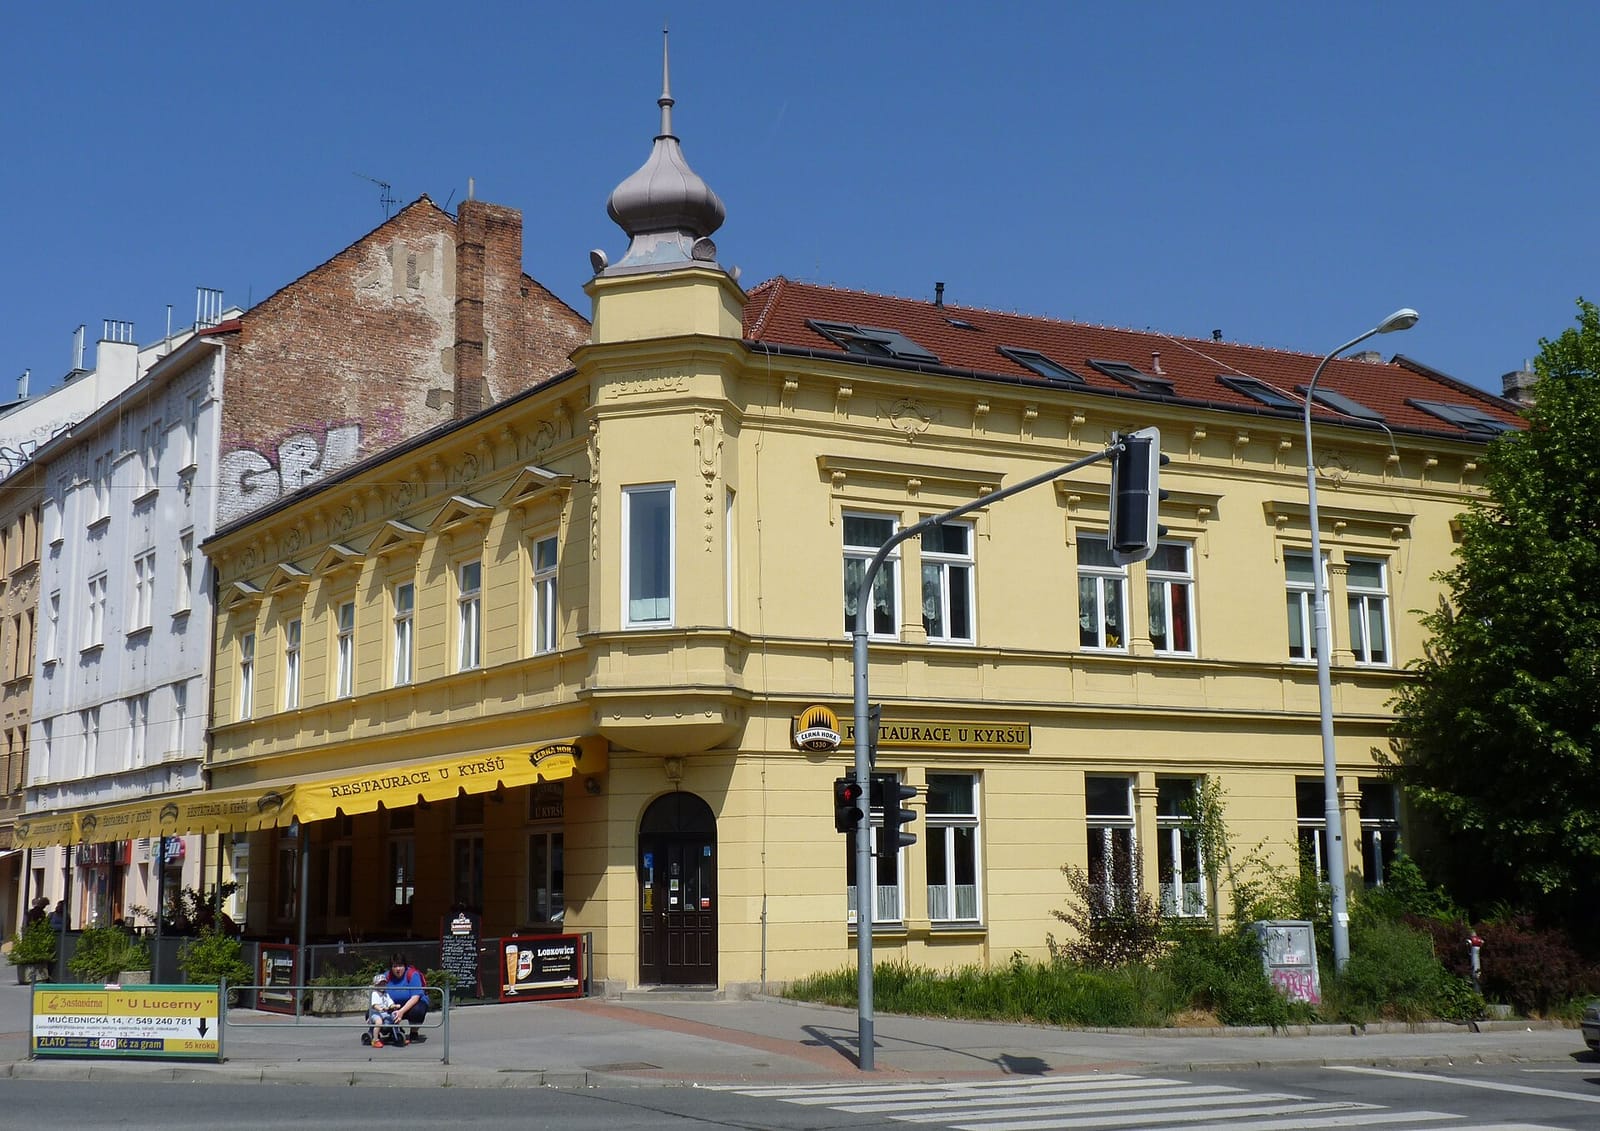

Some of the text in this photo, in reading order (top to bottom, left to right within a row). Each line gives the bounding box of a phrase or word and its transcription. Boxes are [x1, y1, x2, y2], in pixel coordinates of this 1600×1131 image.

[821, 732, 837, 741] HORA
[846, 725, 1025, 743] RTAURACE U KYRŠŮ
[330, 756, 505, 798] RESTAURACE U KYRŠŮ
[128, 999, 138, 1008] U
[143, 999, 201, 1011] Lucerny
[47, 1016, 109, 1024] MUČEDNICKÁ
[136, 1017, 152, 1025] 549
[40, 1037, 66, 1047] ZLATO
[100, 1039, 115, 1048] 440
[118, 1038, 127, 1048] Kč
[129, 1040, 138, 1049] za
[140, 1041, 161, 1051] gram
